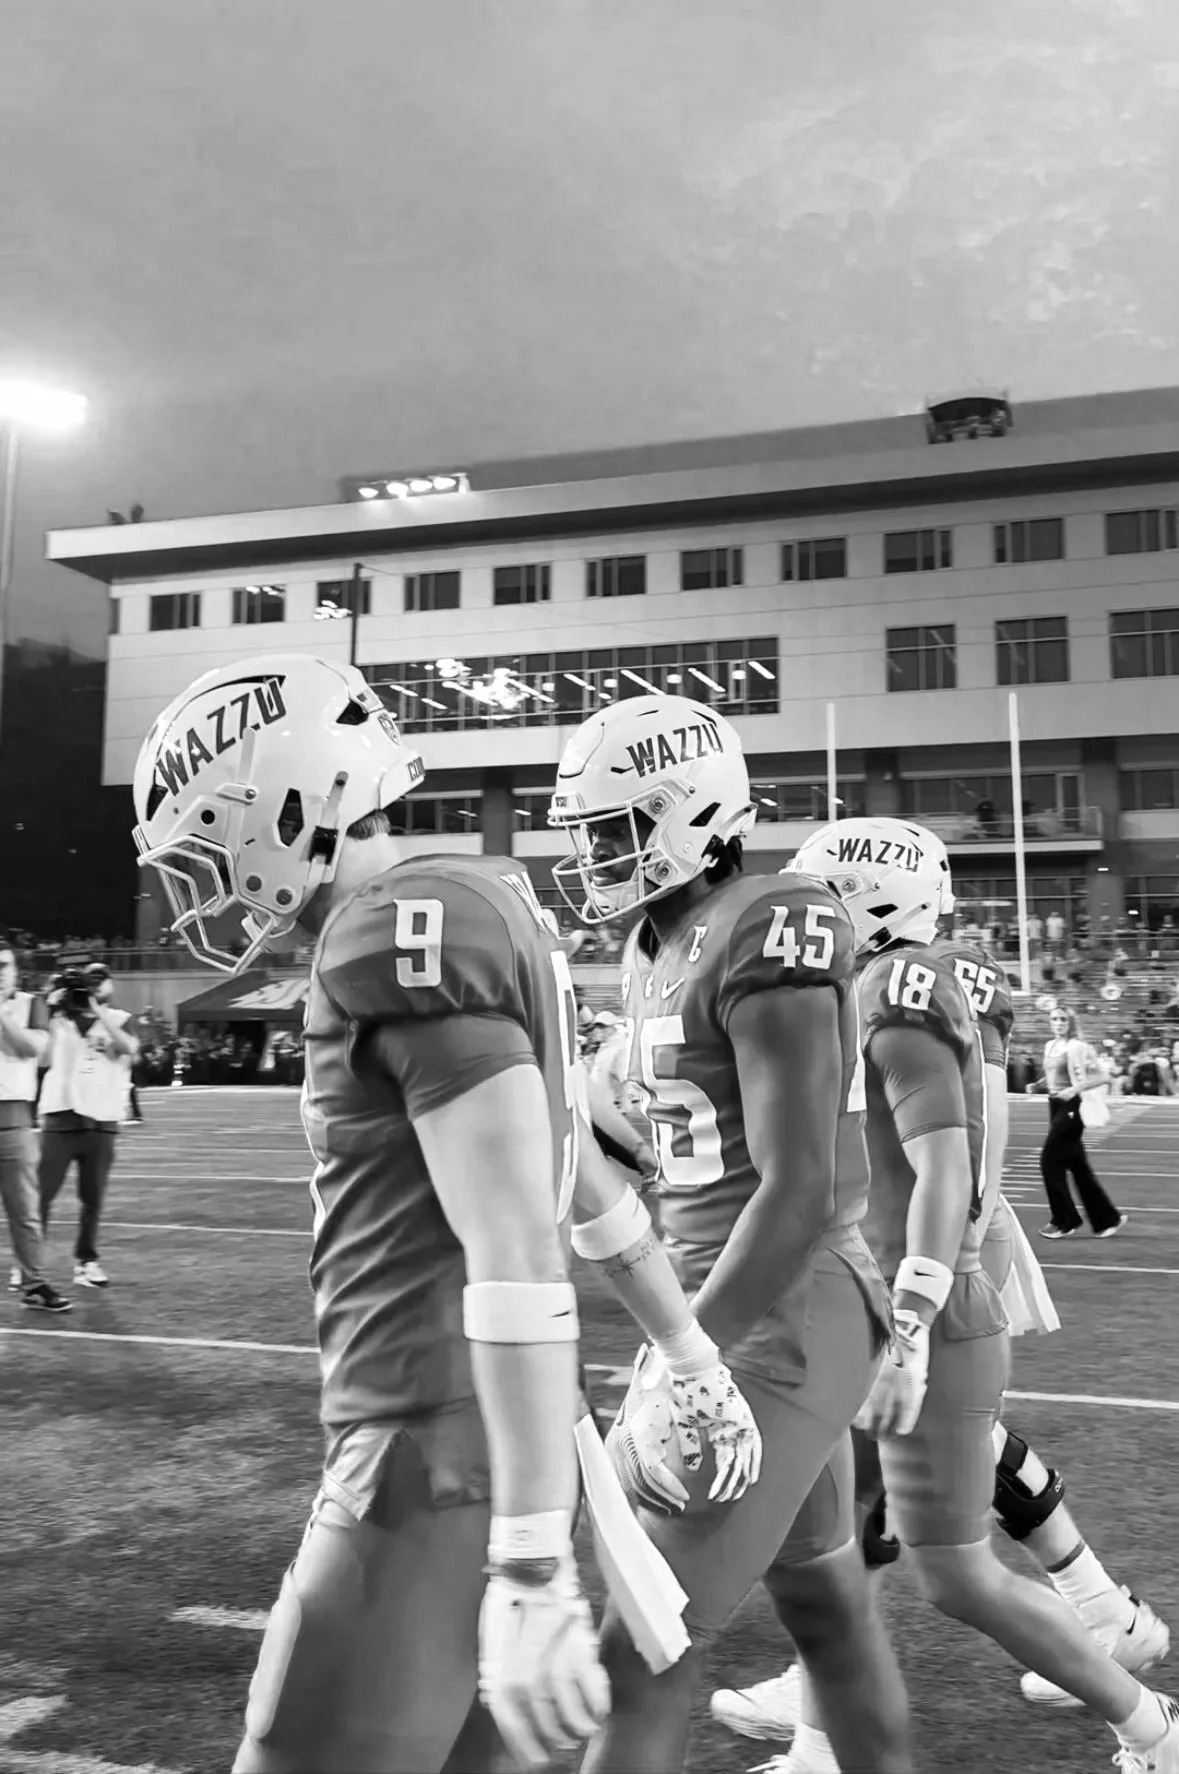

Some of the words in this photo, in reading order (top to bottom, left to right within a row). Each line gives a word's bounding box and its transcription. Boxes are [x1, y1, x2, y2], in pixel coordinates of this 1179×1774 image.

[156, 679, 286, 797] WAZZU
[625, 723, 723, 778] WAZZU
[838, 838, 919, 872] WAZZU
[393, 899, 444, 988] 9
[763, 904, 836, 970] 45
[888, 959, 936, 1010] 18
[954, 958, 996, 1013] 65
